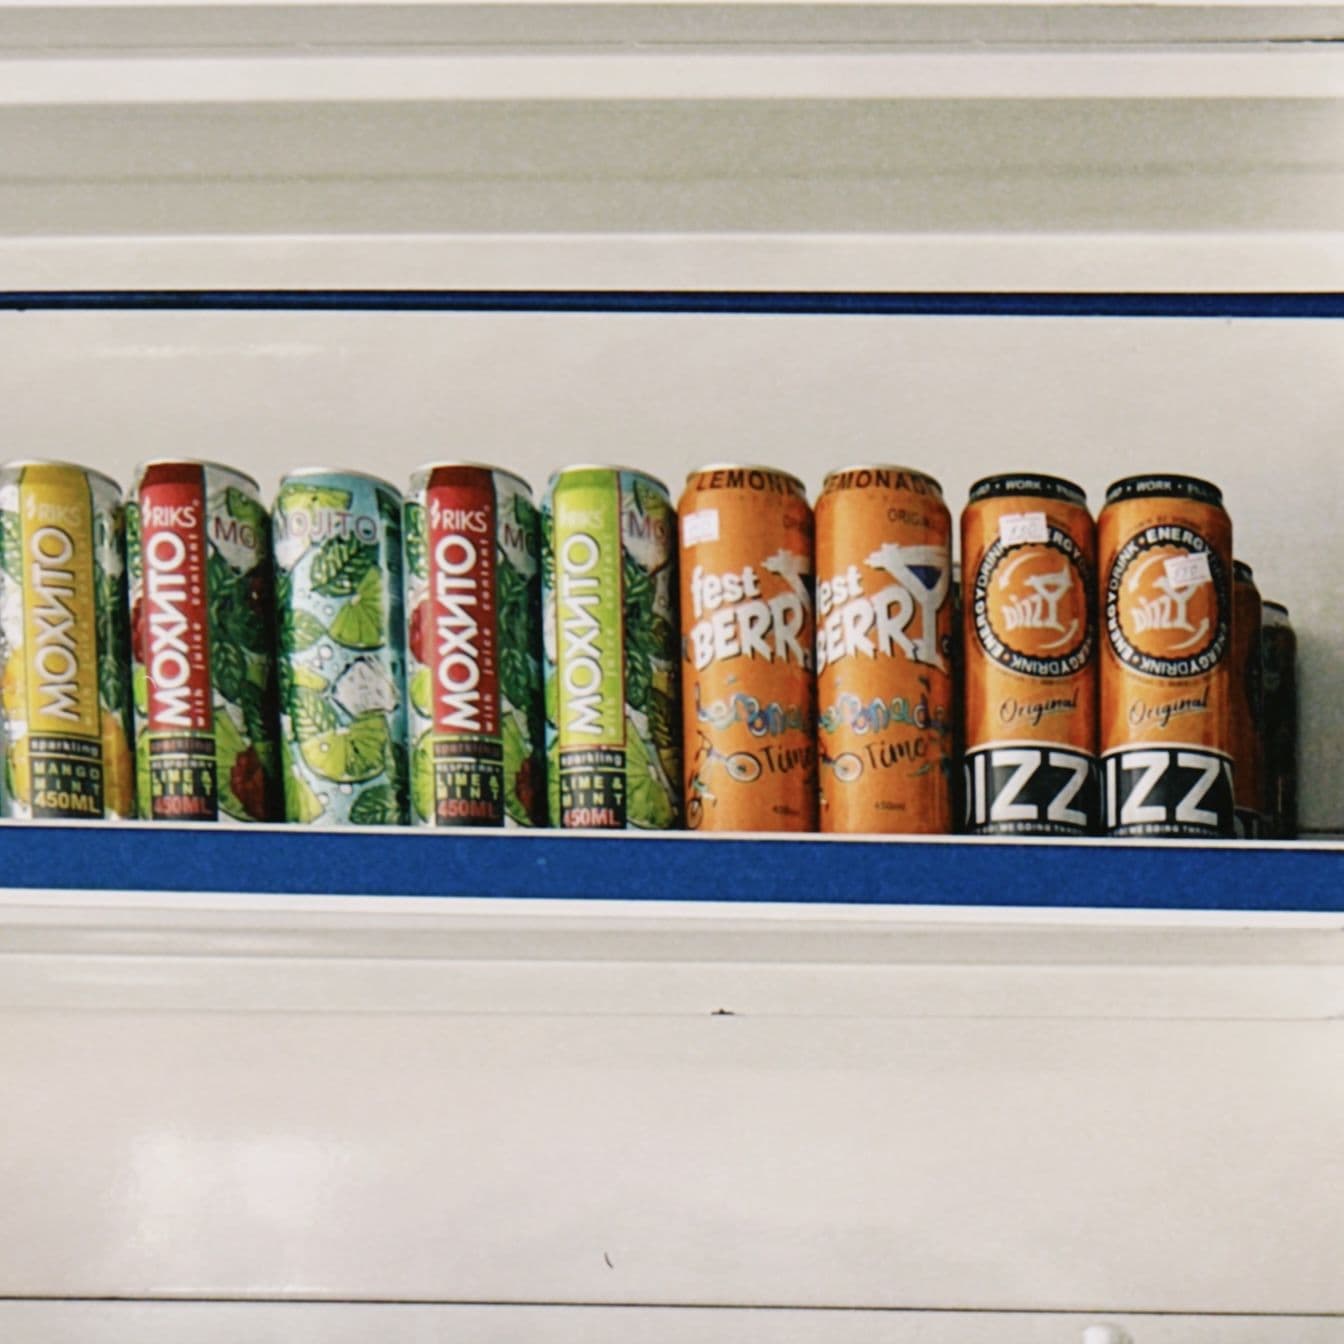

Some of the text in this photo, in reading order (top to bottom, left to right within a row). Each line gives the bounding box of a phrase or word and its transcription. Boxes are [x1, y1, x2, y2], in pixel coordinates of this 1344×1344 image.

[154, 504, 197, 529] RIKS
[442, 508, 488, 533] RIKS
[691, 565, 763, 619] fest
[34, 762, 100, 780] MANGO
[36, 791, 100, 814] 450ML
